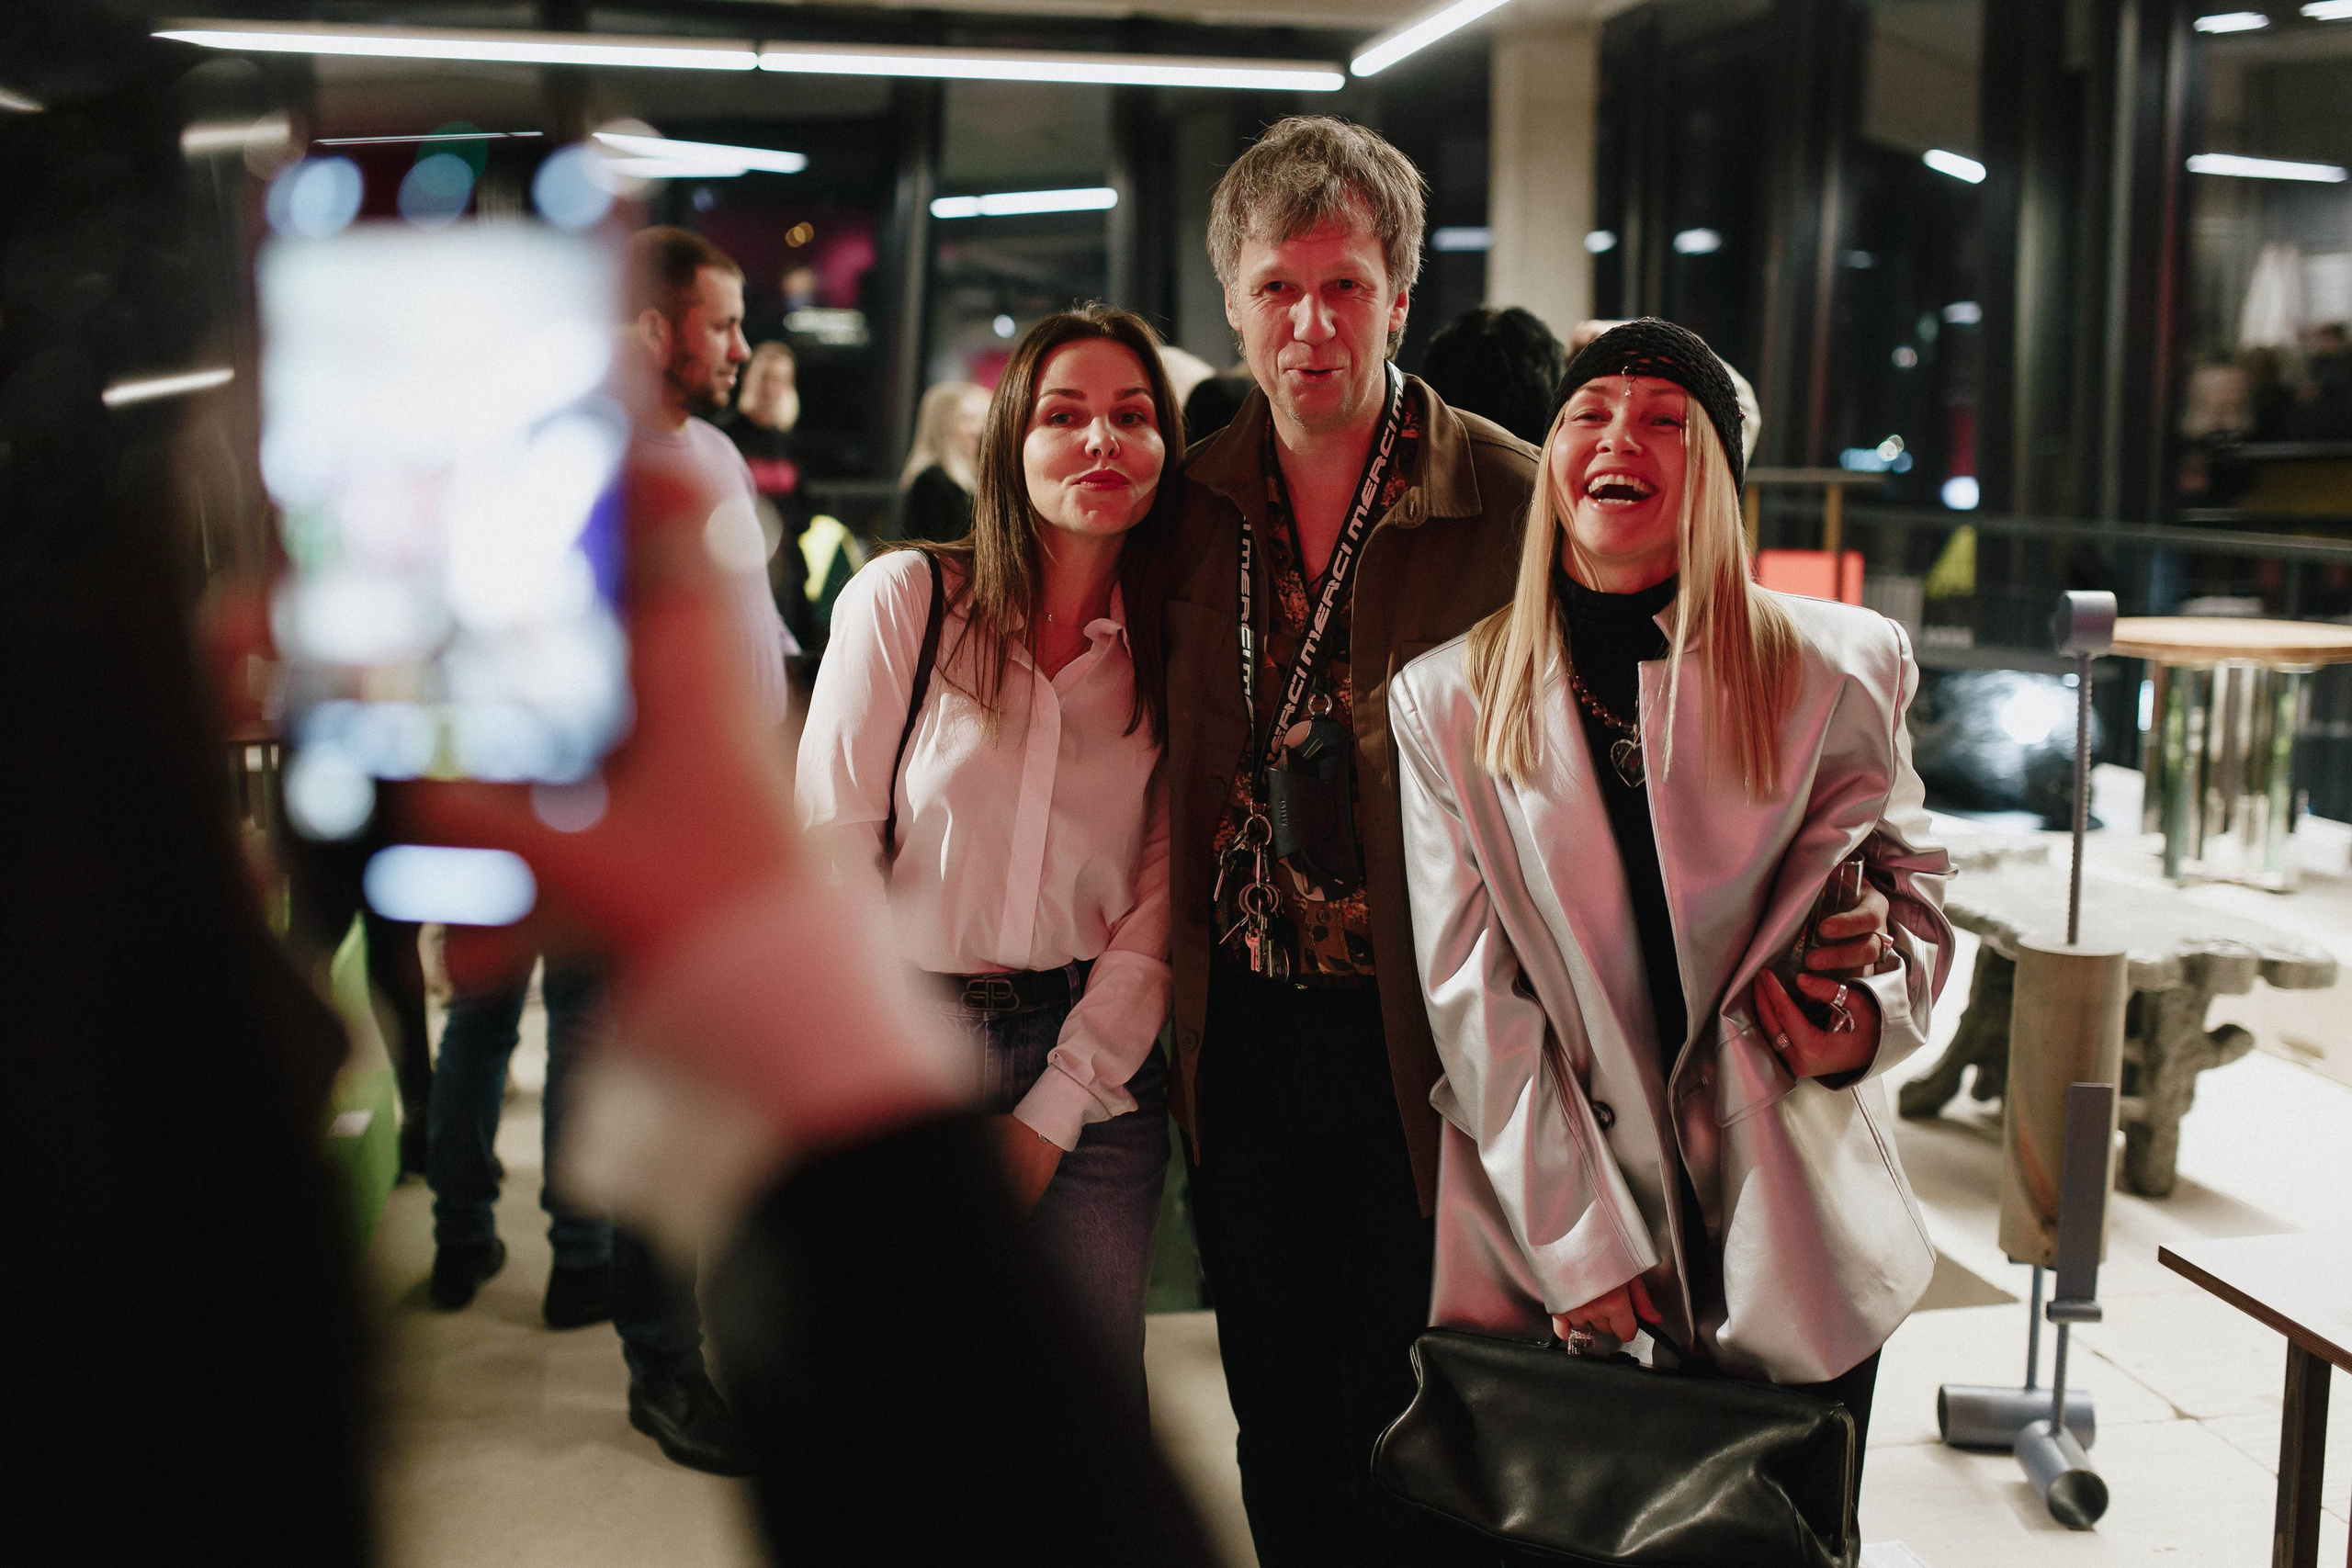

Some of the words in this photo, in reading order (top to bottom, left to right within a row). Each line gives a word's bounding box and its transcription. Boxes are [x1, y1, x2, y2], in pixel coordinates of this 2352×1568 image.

[1241, 537, 1251, 659] MERCI
[1300, 542, 1352, 666] MERCI
[1347, 419, 1397, 541] MERCI
